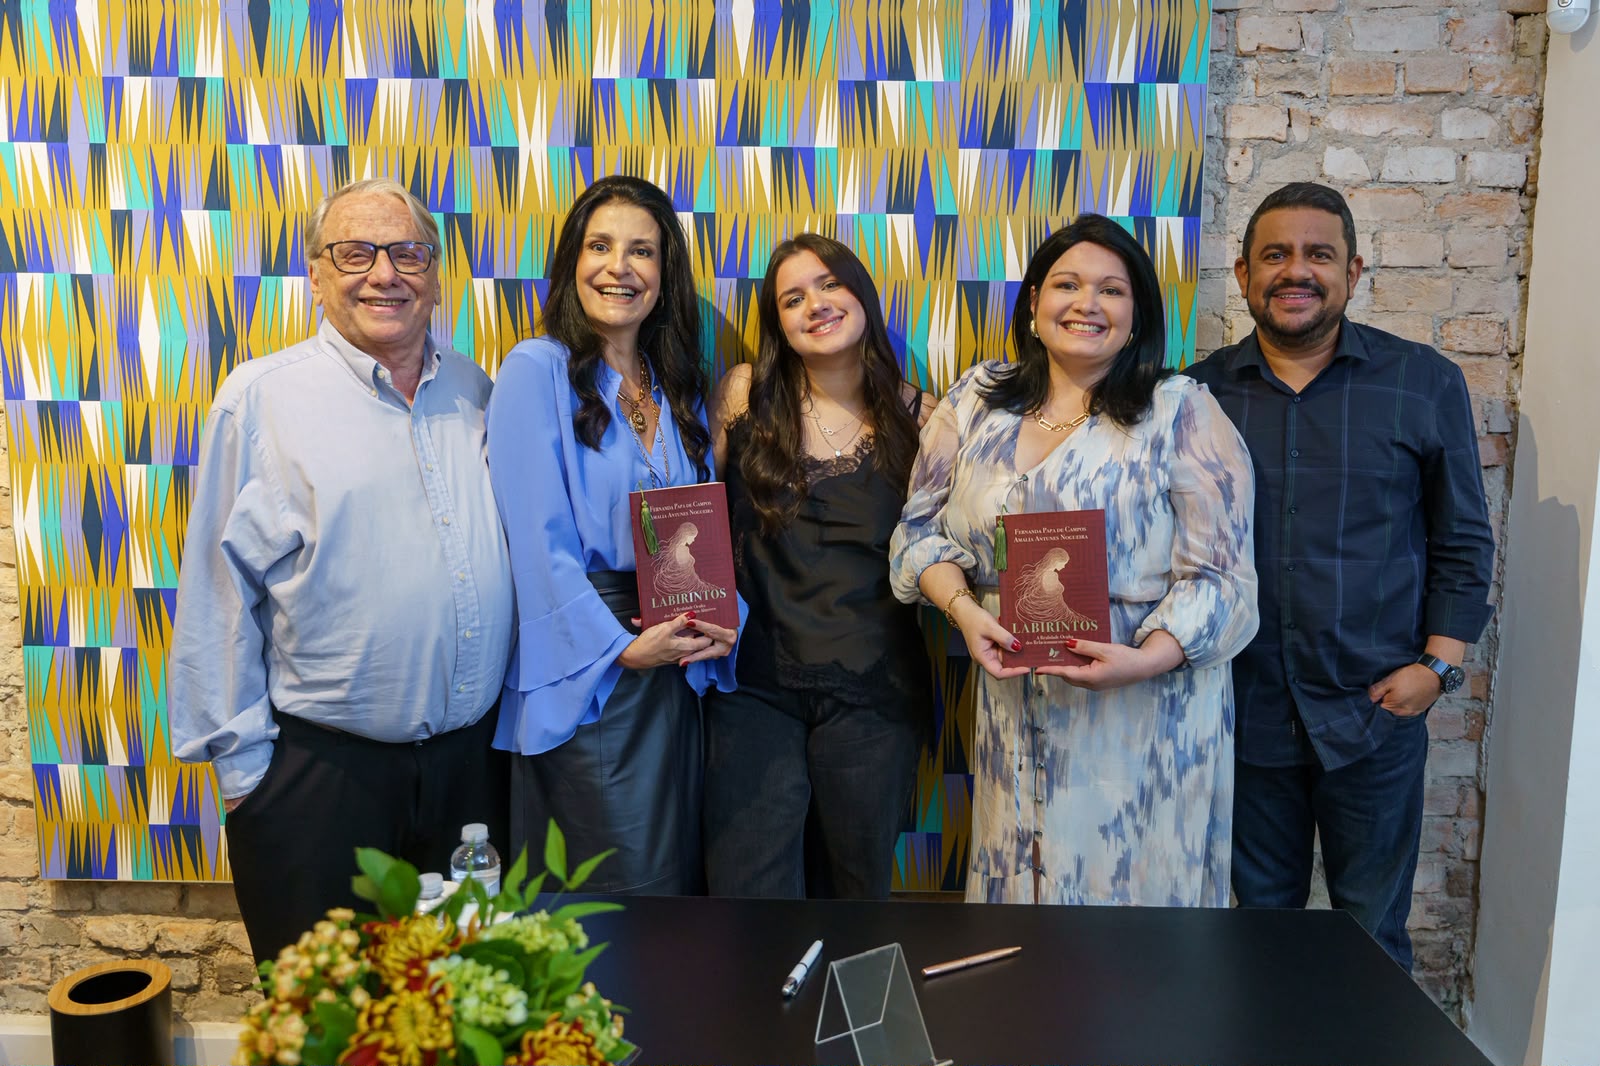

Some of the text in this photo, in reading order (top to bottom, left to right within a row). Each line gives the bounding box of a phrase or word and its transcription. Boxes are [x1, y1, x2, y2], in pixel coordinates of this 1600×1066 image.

[650, 505, 673, 513] FERNANDA
[652, 587, 727, 608] LABIRINTOS
[1012, 620, 1098, 634] LABIRINTOS
